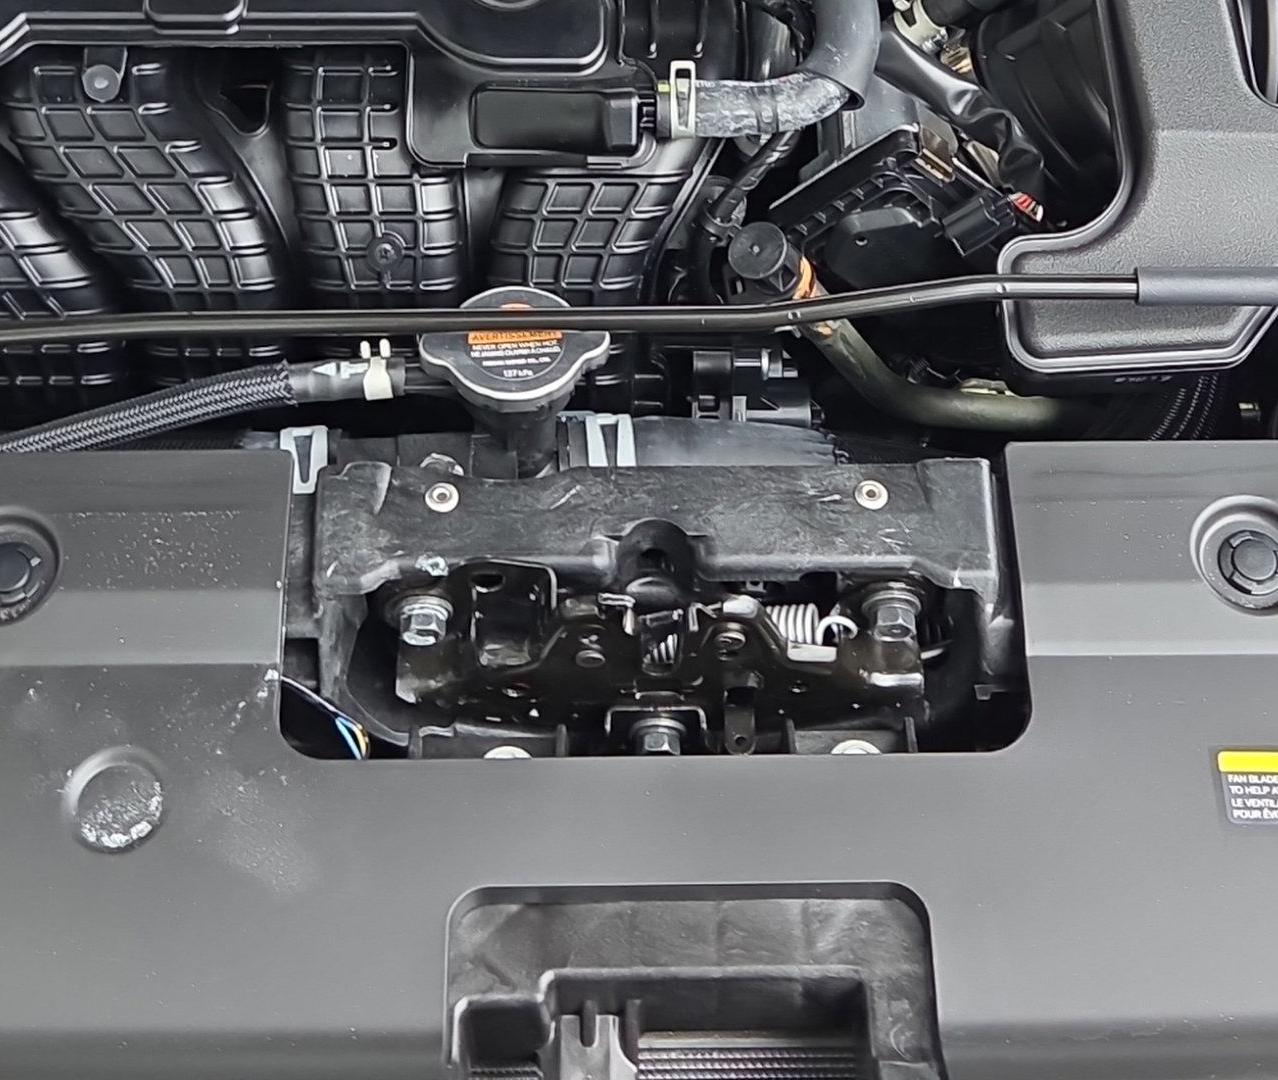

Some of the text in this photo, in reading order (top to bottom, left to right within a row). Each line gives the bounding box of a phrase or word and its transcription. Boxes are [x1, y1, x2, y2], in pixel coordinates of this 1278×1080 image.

[1227, 775, 1248, 784] FAN
[1229, 785, 1244, 795] TO
[1245, 786, 1271, 795] HELP
[1231, 798, 1244, 808] LE
[1233, 809, 1262, 820] POUR
